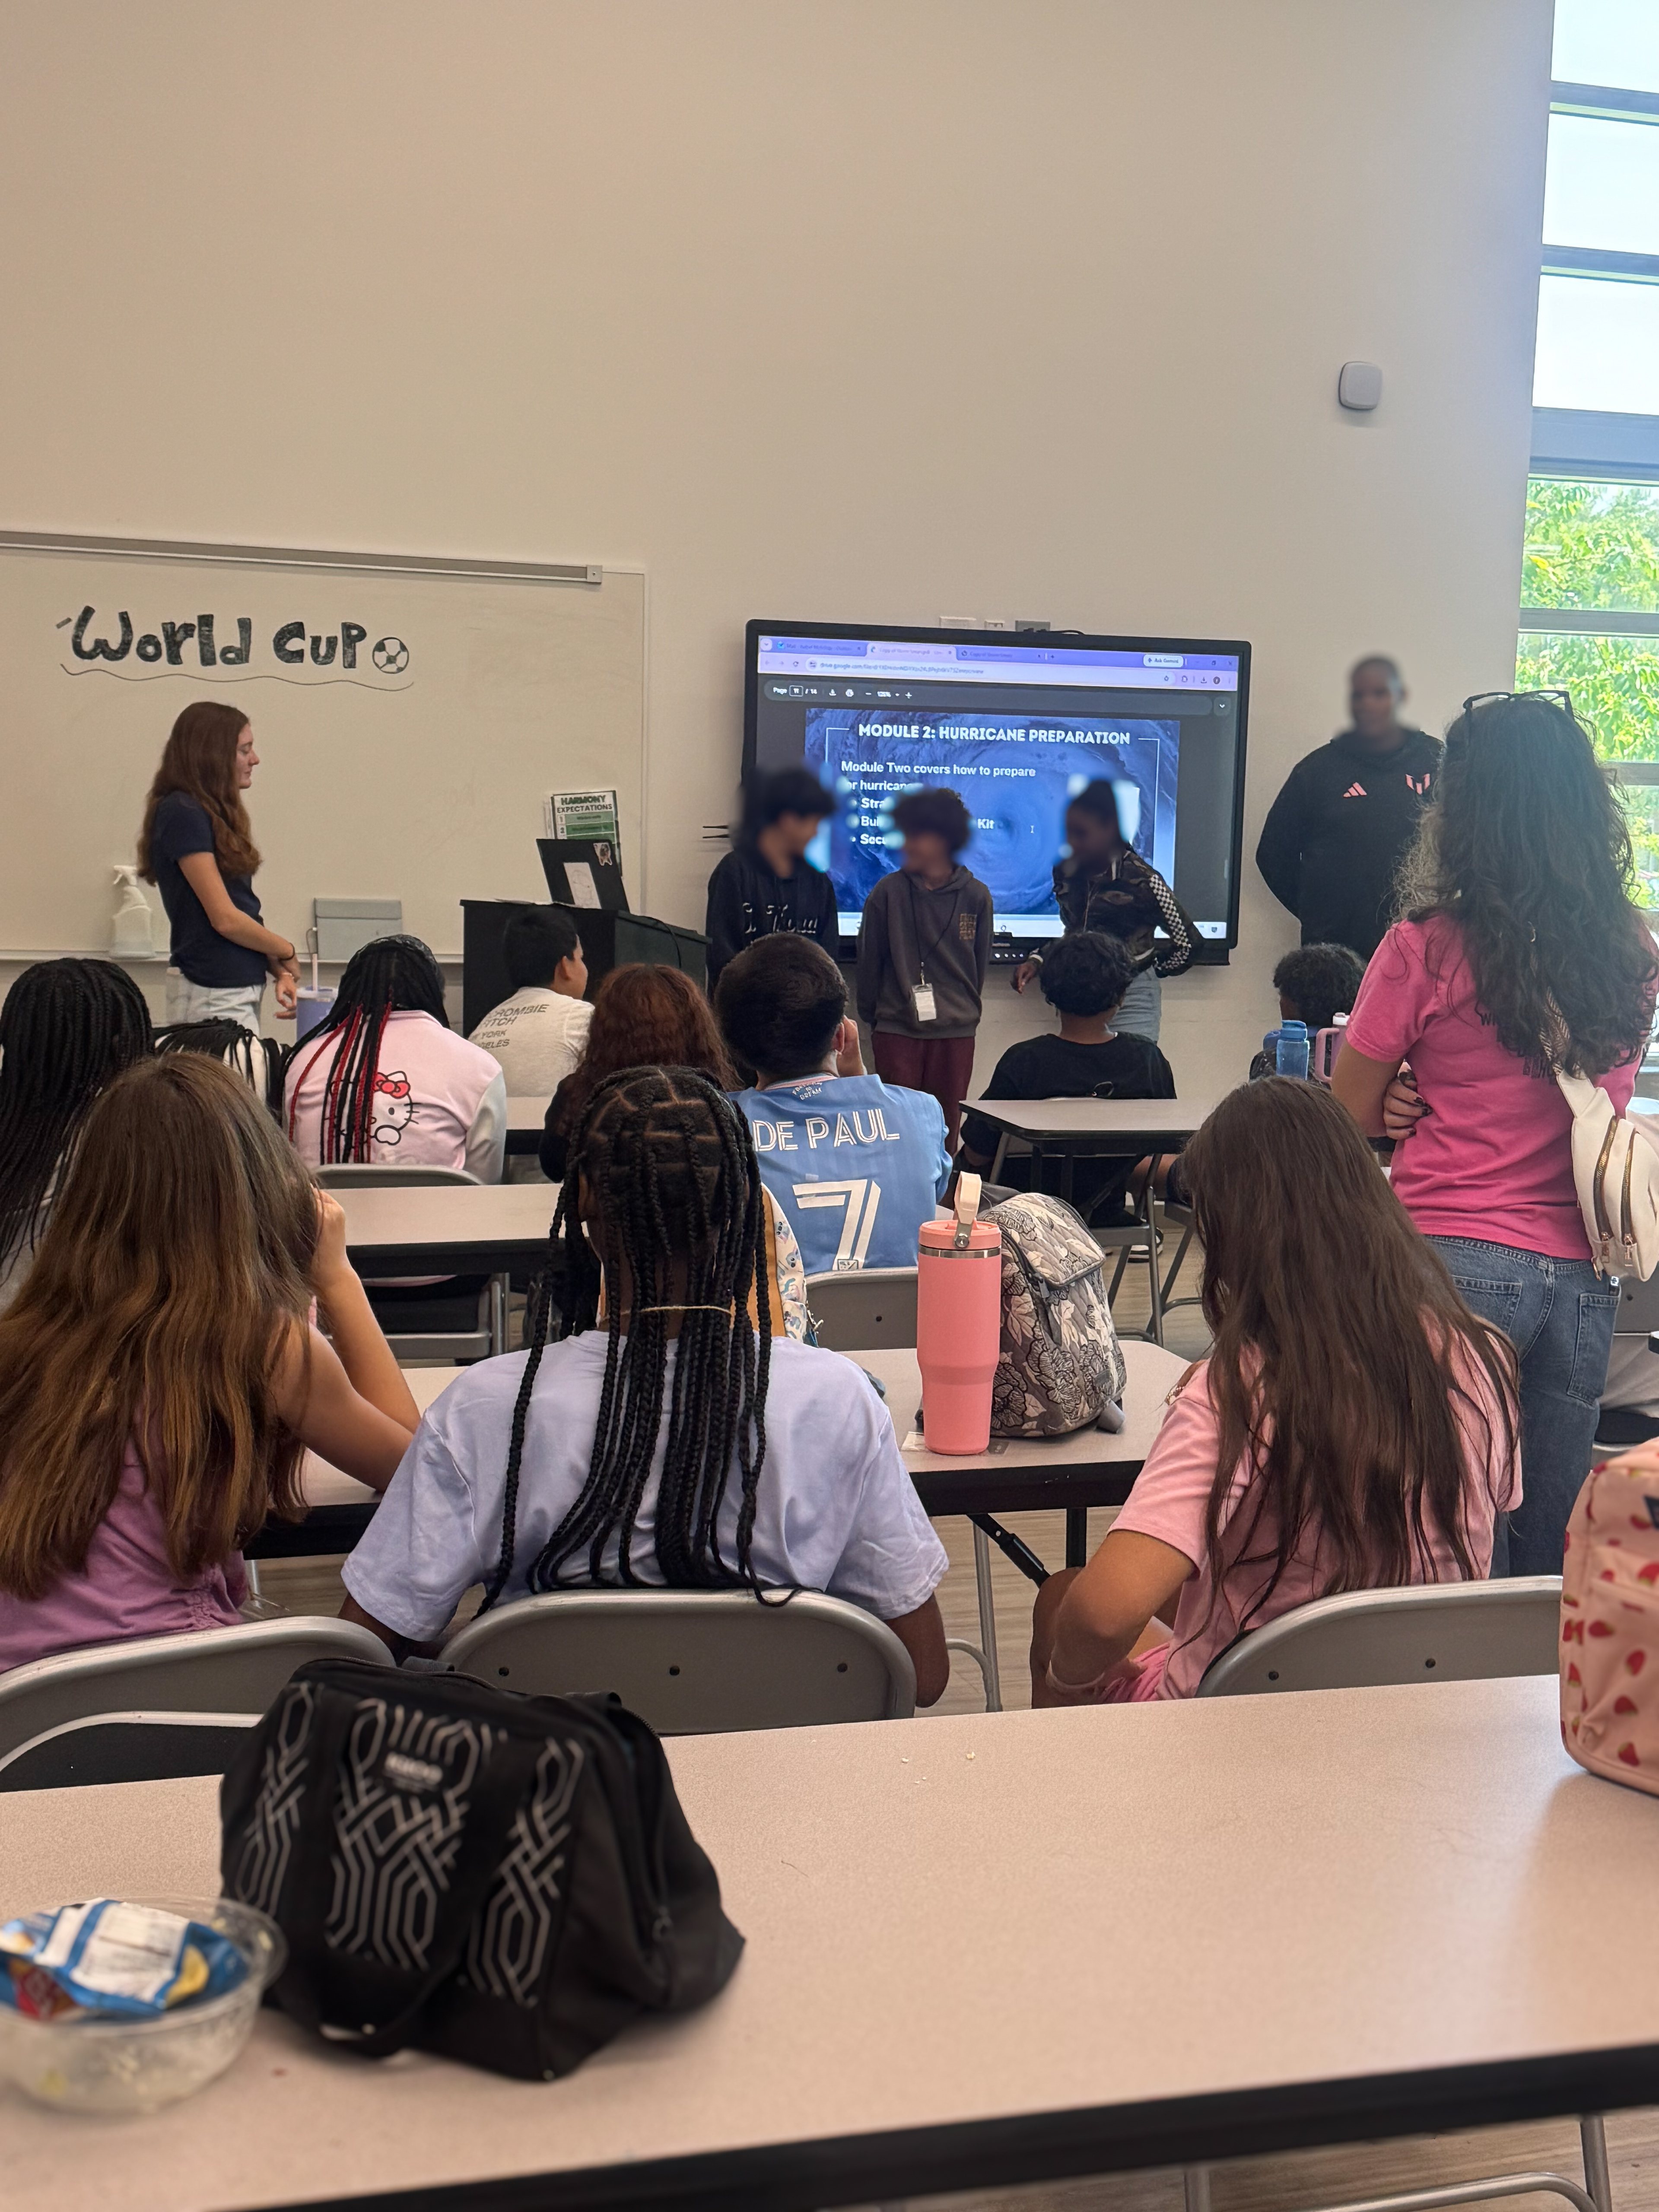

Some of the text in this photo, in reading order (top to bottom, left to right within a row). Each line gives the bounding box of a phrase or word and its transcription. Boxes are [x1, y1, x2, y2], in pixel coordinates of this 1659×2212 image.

[72, 606, 251, 666] World
[858, 724, 1130, 745] MODULE 2: HURRICANE PREPARATION
[842, 761, 1036, 778] Module Two covers how to prepare
[557, 804, 613, 813] EXPECTATIONS
[561, 795, 606, 805] HARMONY
[977, 818, 994, 829] Kit
[752, 1109, 900, 1151] DE PAUL
[792, 1179, 881, 1271] 7
